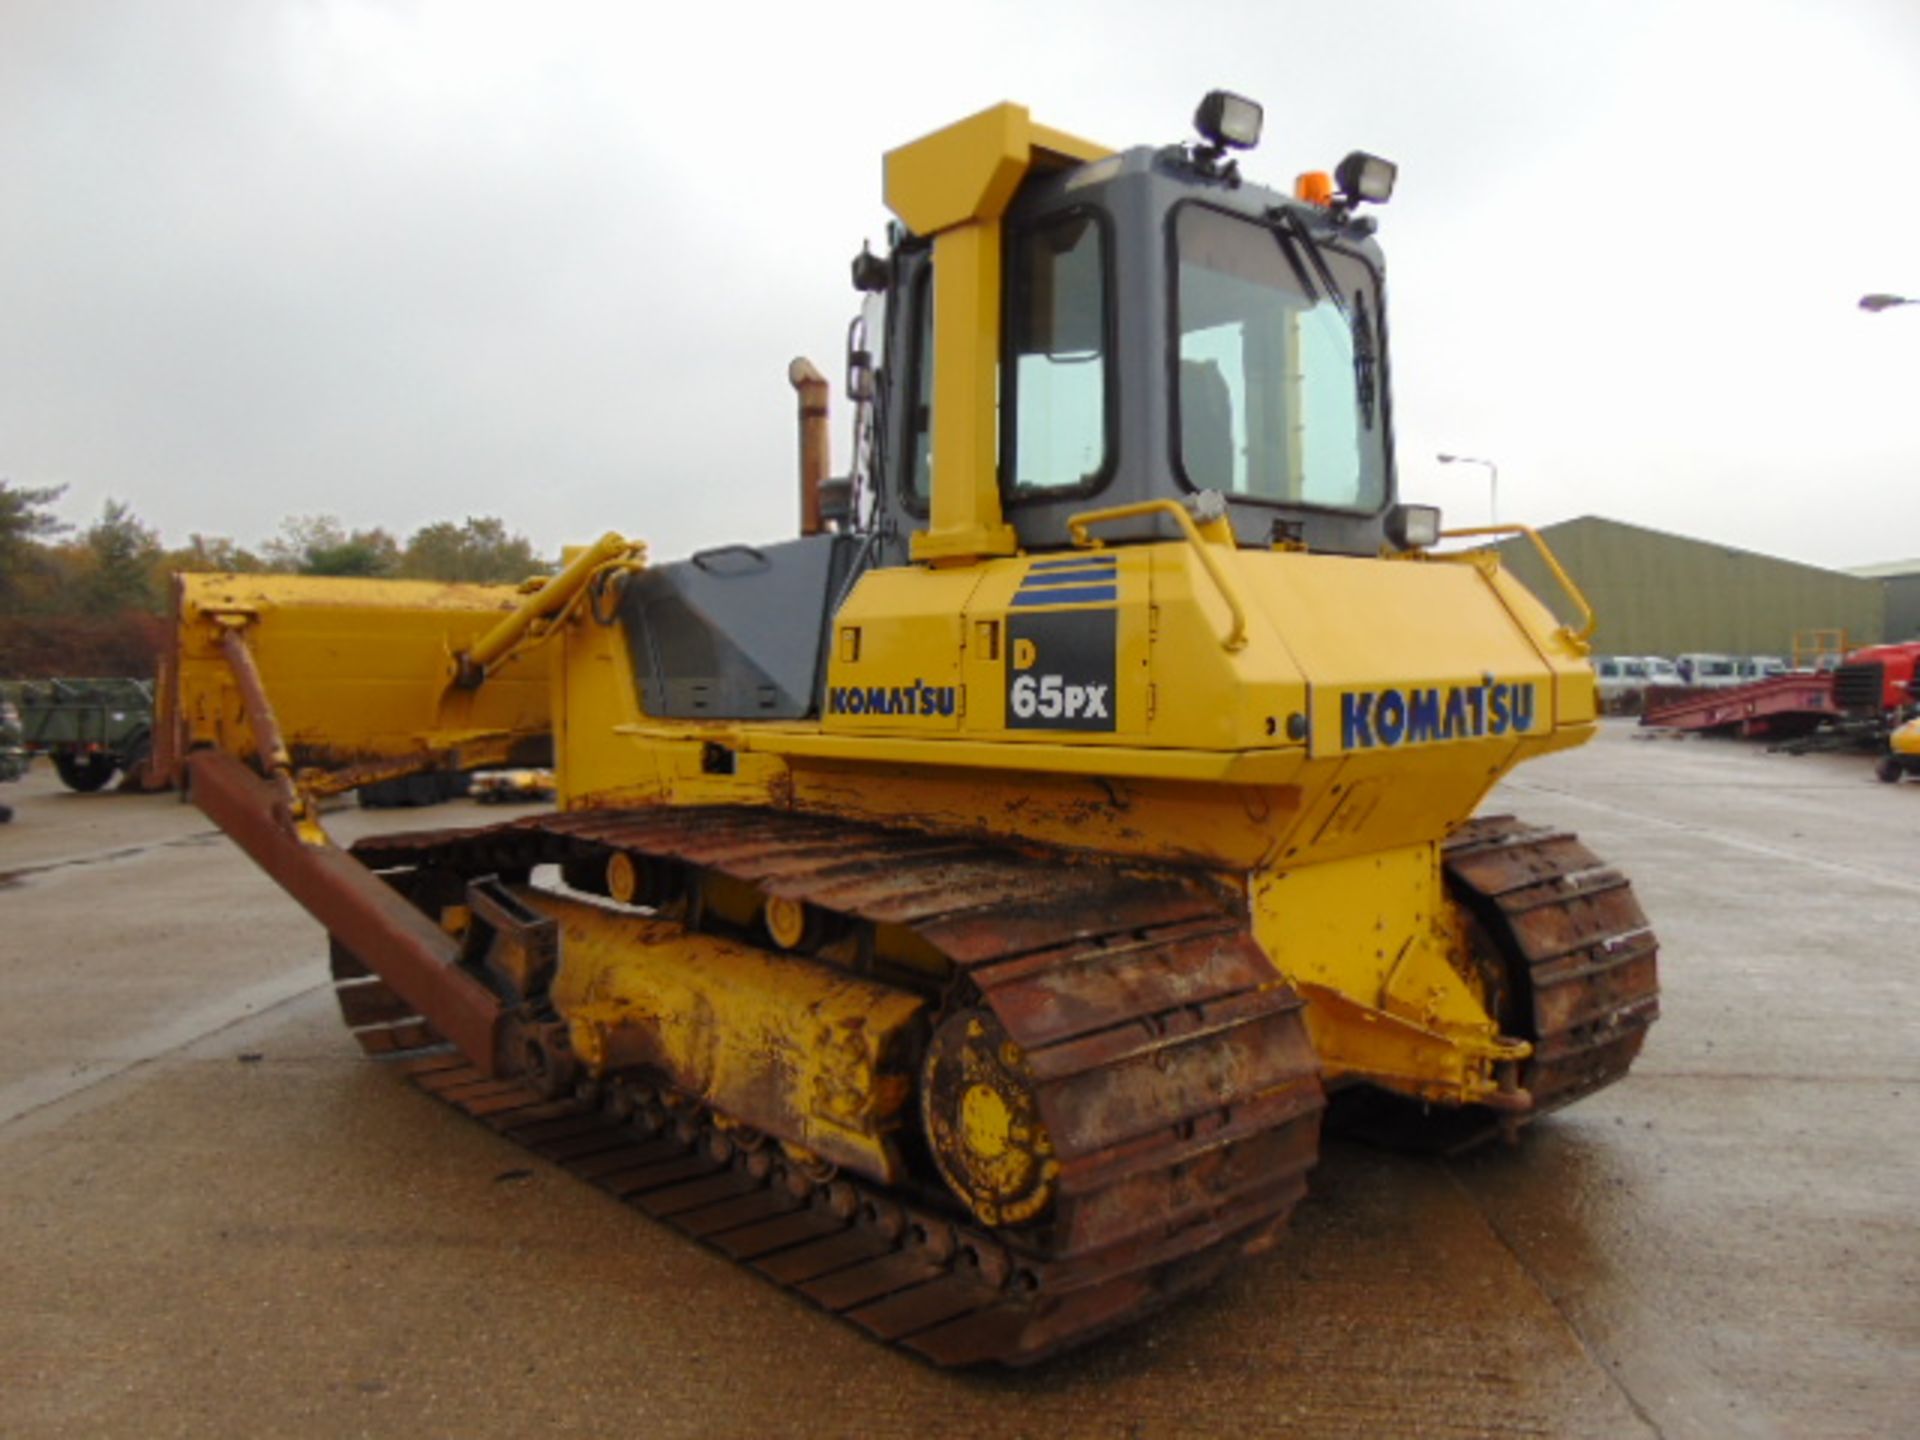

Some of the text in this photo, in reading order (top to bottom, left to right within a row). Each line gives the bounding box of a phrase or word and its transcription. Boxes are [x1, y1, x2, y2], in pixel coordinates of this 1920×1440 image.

[1014, 639, 1036, 669] D
[829, 679, 955, 715] KOMATSU
[1011, 676, 1108, 719] 65PX
[1341, 671, 1535, 749] KOMATSU
